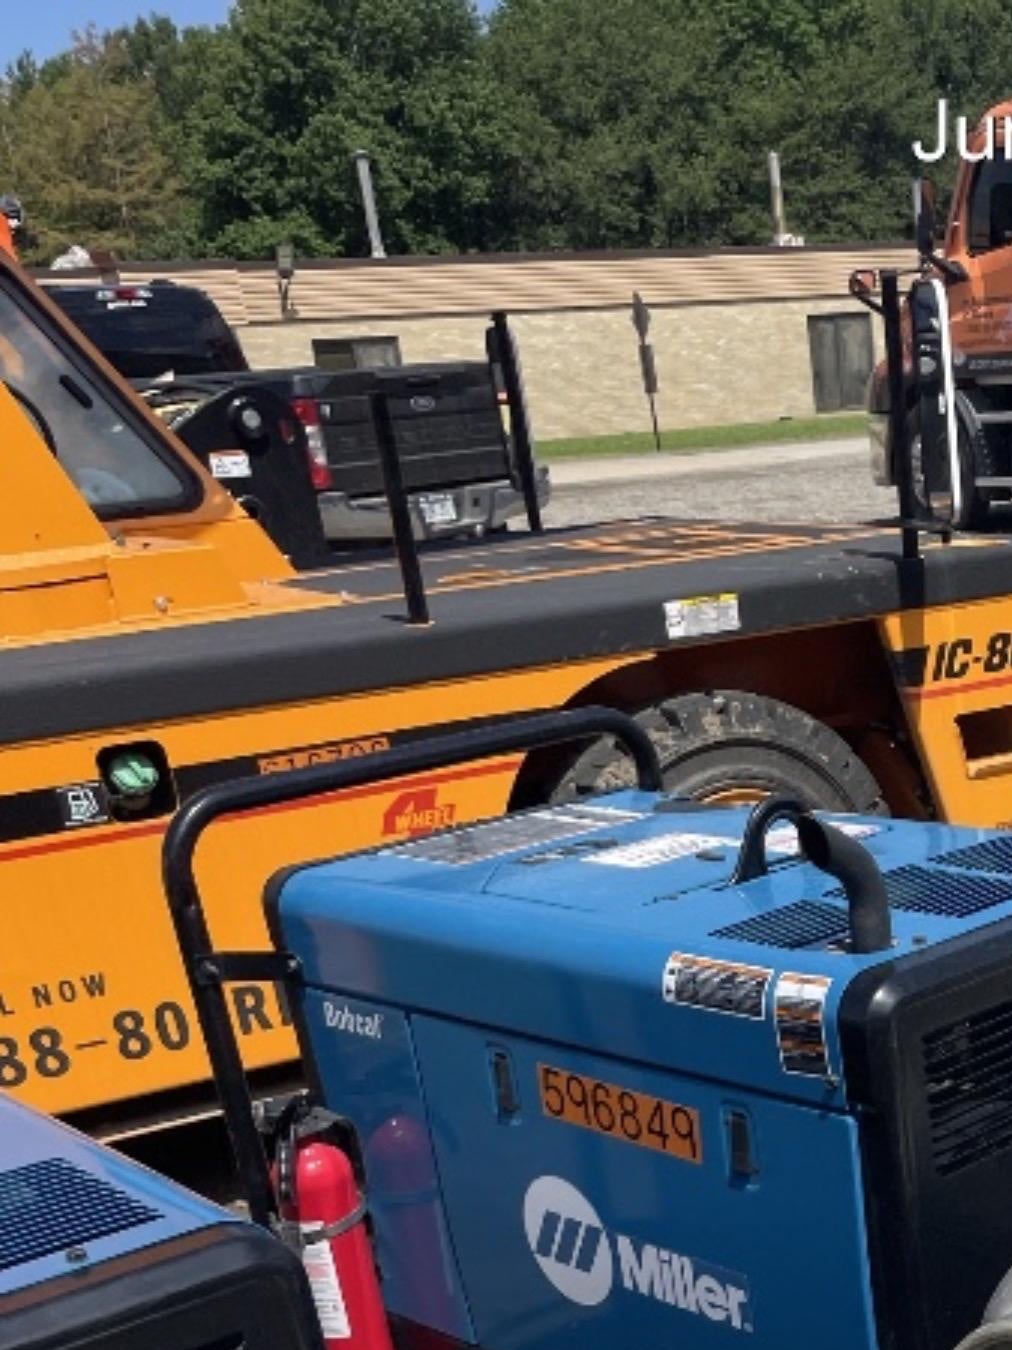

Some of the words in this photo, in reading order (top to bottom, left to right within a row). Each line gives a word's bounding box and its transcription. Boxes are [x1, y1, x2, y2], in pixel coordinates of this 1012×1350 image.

[31, 971, 106, 1009] NOW
[322, 1001, 383, 1039] Bobcat
[541, 1066, 698, 1159] 596849
[616, 1233, 750, 1331] Miller
